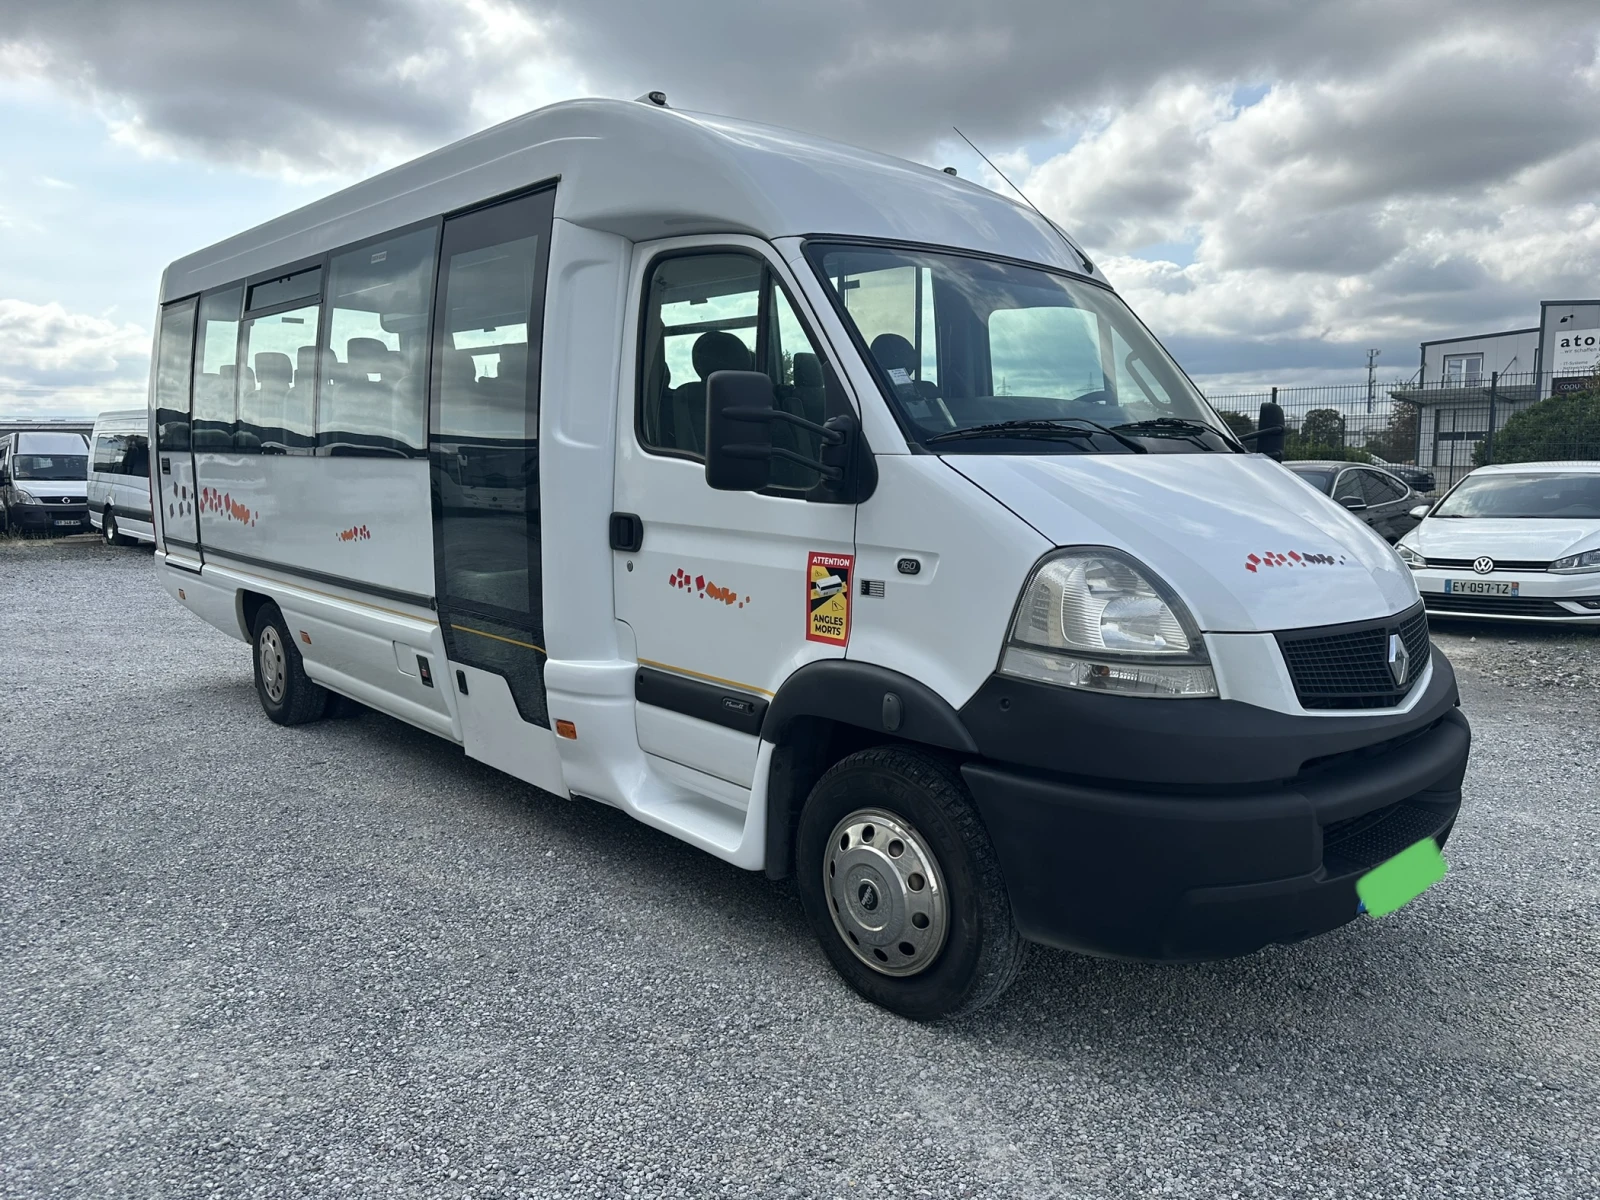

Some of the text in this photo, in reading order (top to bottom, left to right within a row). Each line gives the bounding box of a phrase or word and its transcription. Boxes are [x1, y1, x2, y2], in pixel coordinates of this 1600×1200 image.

[1560, 335, 1600, 347] ato
[812, 556, 850, 566] ATTENTION
[900, 560, 916, 570] 160
[1453, 582, 1509, 594] EY-097-TZ
[813, 614, 843, 626] ANGLES
[815, 624, 841, 636] MORTS
